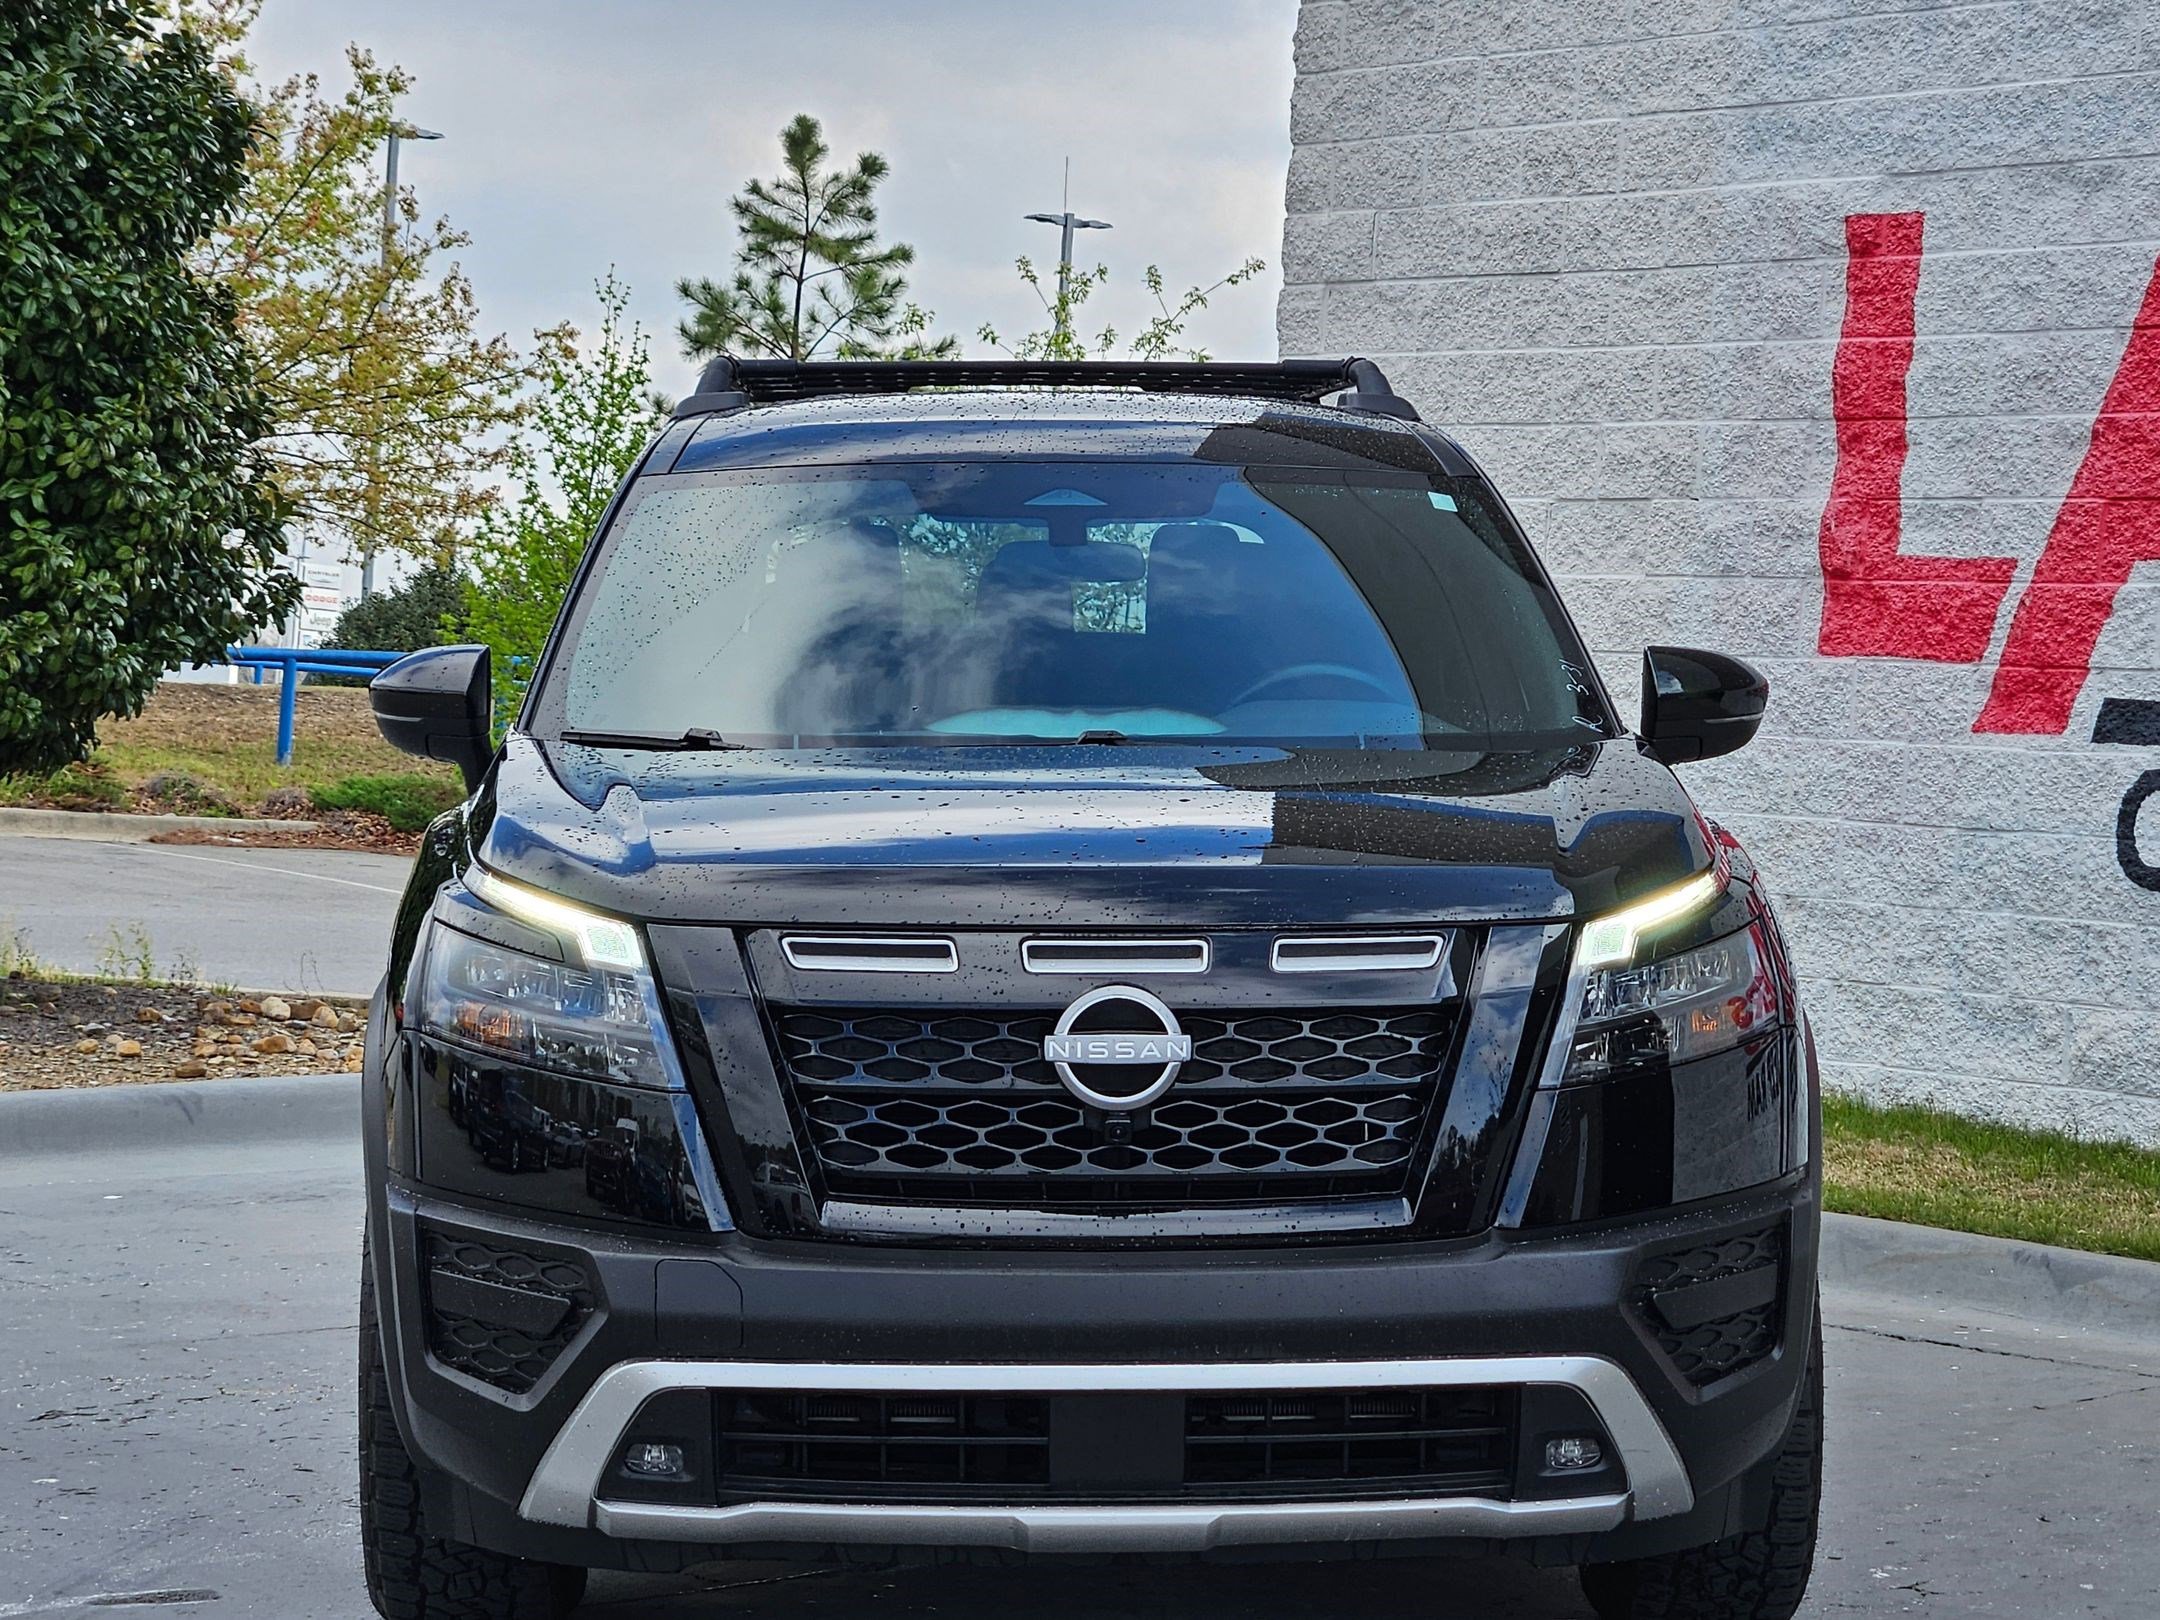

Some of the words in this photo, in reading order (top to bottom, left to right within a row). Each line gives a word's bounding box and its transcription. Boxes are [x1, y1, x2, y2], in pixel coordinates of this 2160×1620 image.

[304, 594, 338, 604] DODGE
[310, 613, 332, 628] Jeep
[1048, 1040, 1188, 1059] NISSAN
